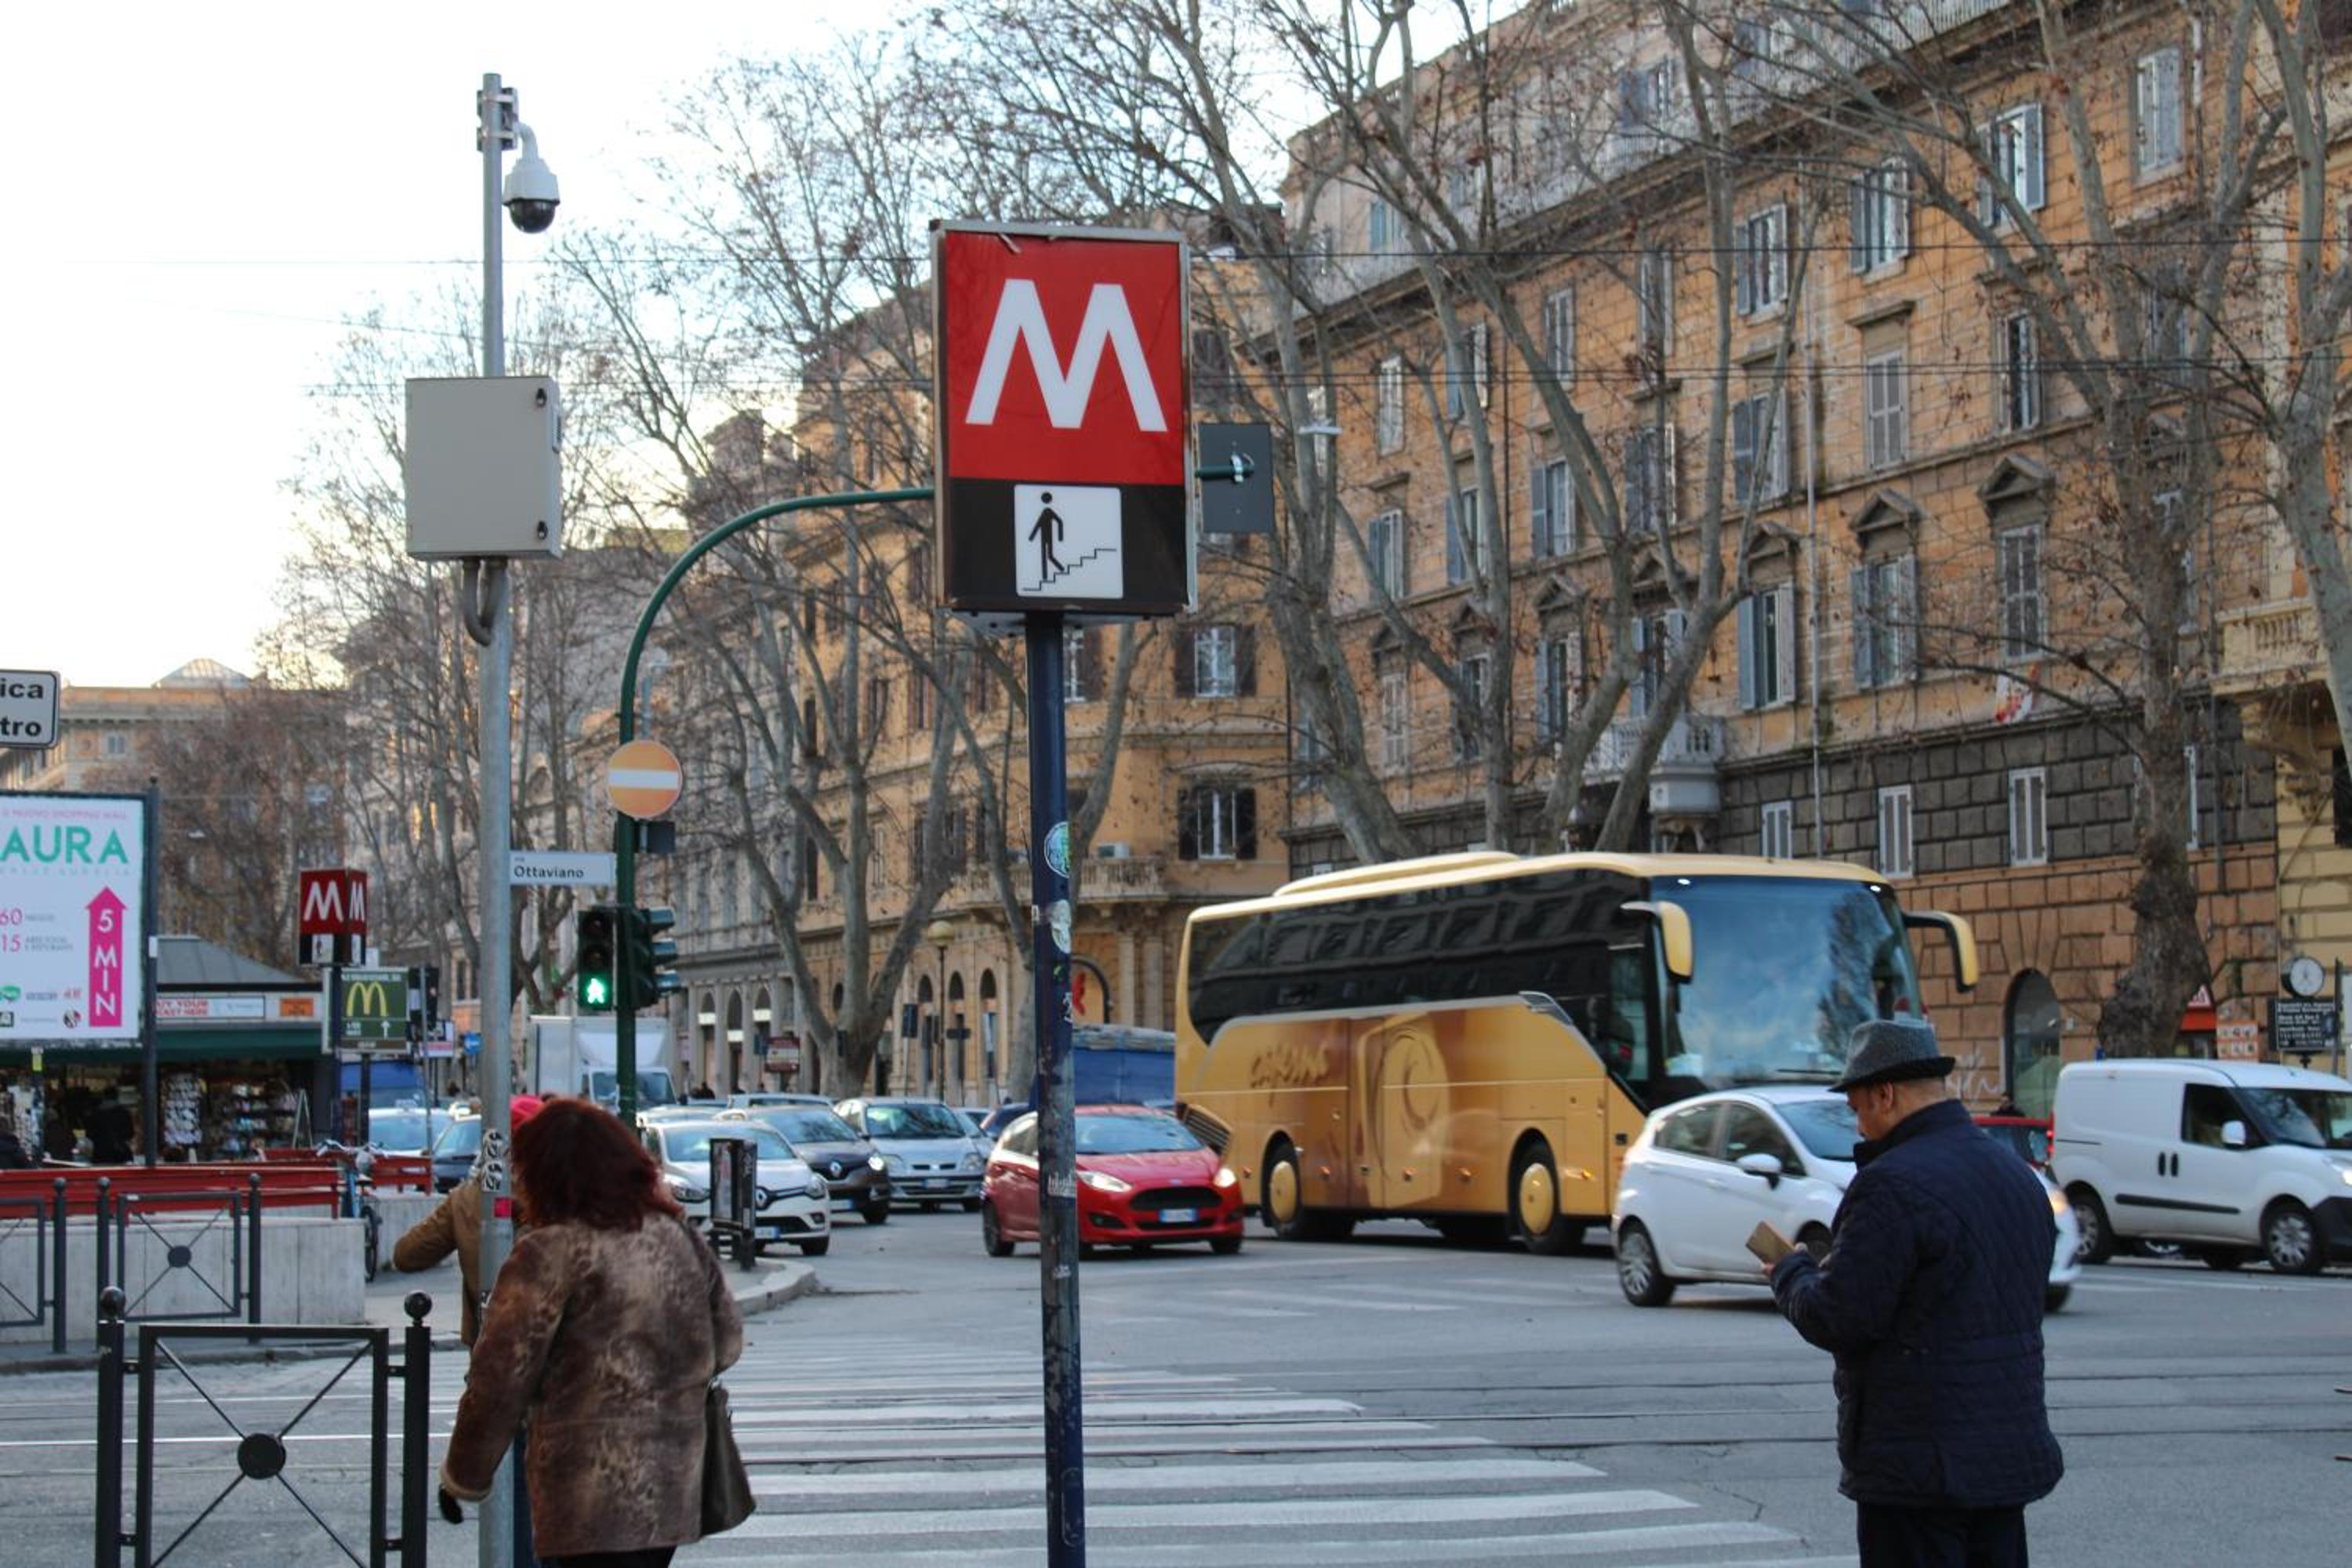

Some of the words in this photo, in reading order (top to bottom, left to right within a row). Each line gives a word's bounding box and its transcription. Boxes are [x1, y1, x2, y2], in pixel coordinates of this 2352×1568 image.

[966, 279, 1167, 432] M
[0, 826, 129, 864] AURA
[514, 865, 584, 879] Ottaviano
[97, 908, 114, 933] 5
[303, 880, 344, 923] M
[93, 943, 118, 1017] MIN
